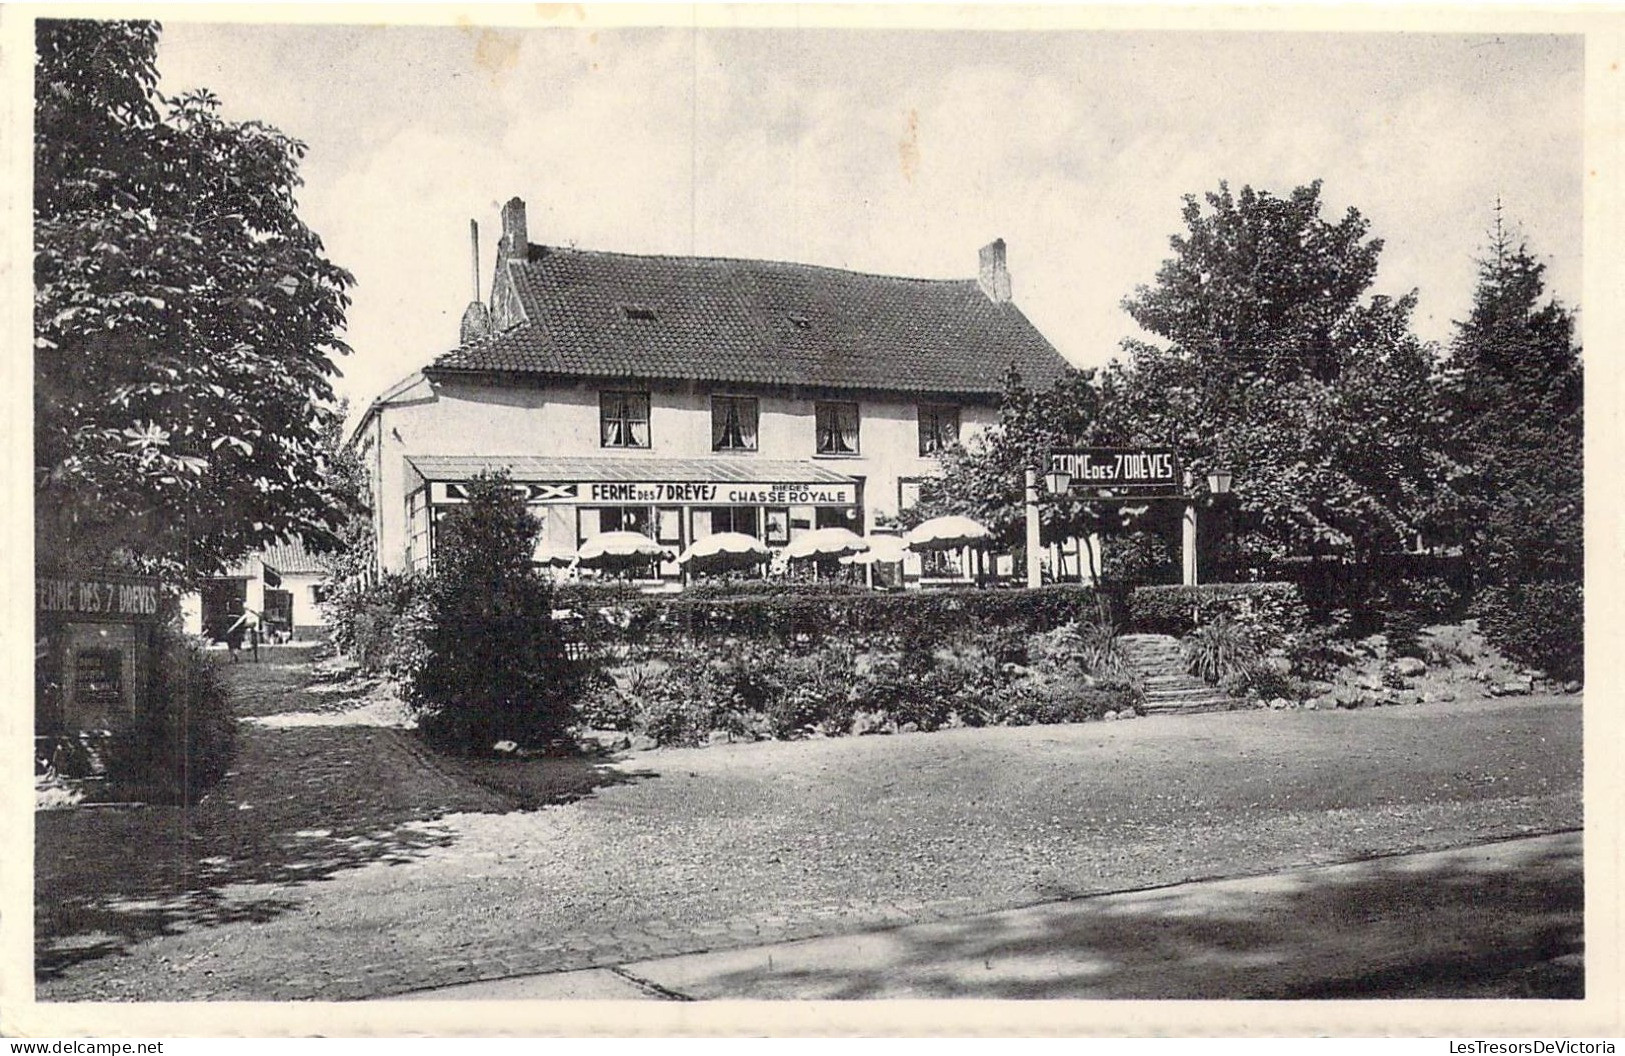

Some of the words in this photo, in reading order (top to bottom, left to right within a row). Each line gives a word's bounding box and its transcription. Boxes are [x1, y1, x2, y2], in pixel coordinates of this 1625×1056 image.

[1092, 465, 1114, 479] DES
[1114, 455, 1123, 479] 7
[591, 484, 636, 500] FERME
[638, 490, 655, 500] DES
[655, 484, 664, 500] 7
[728, 491, 786, 502] CHASSE
[789, 491, 845, 502] ROYALE
[106, 583, 114, 613] 7
